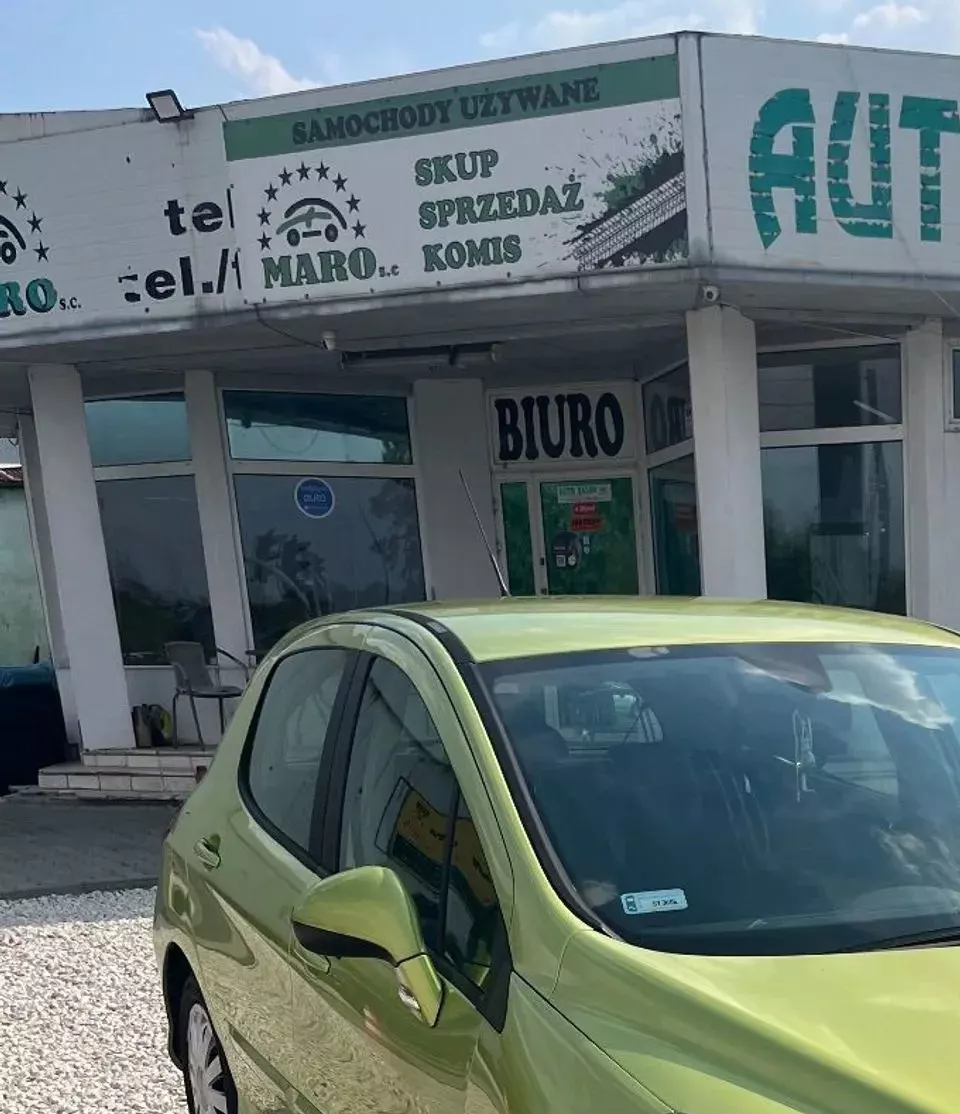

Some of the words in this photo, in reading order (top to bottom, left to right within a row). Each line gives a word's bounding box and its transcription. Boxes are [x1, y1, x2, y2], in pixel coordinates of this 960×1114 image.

[292, 105, 453, 146] SAMOCHODY
[460, 77, 600, 119] UŻYWANE
[414, 149, 499, 186] SKUP
[418, 181, 585, 230] SPRZEDAŻ
[261, 247, 377, 289] MARO
[421, 234, 523, 273] KOMIS
[494, 392, 624, 460] BIURO
